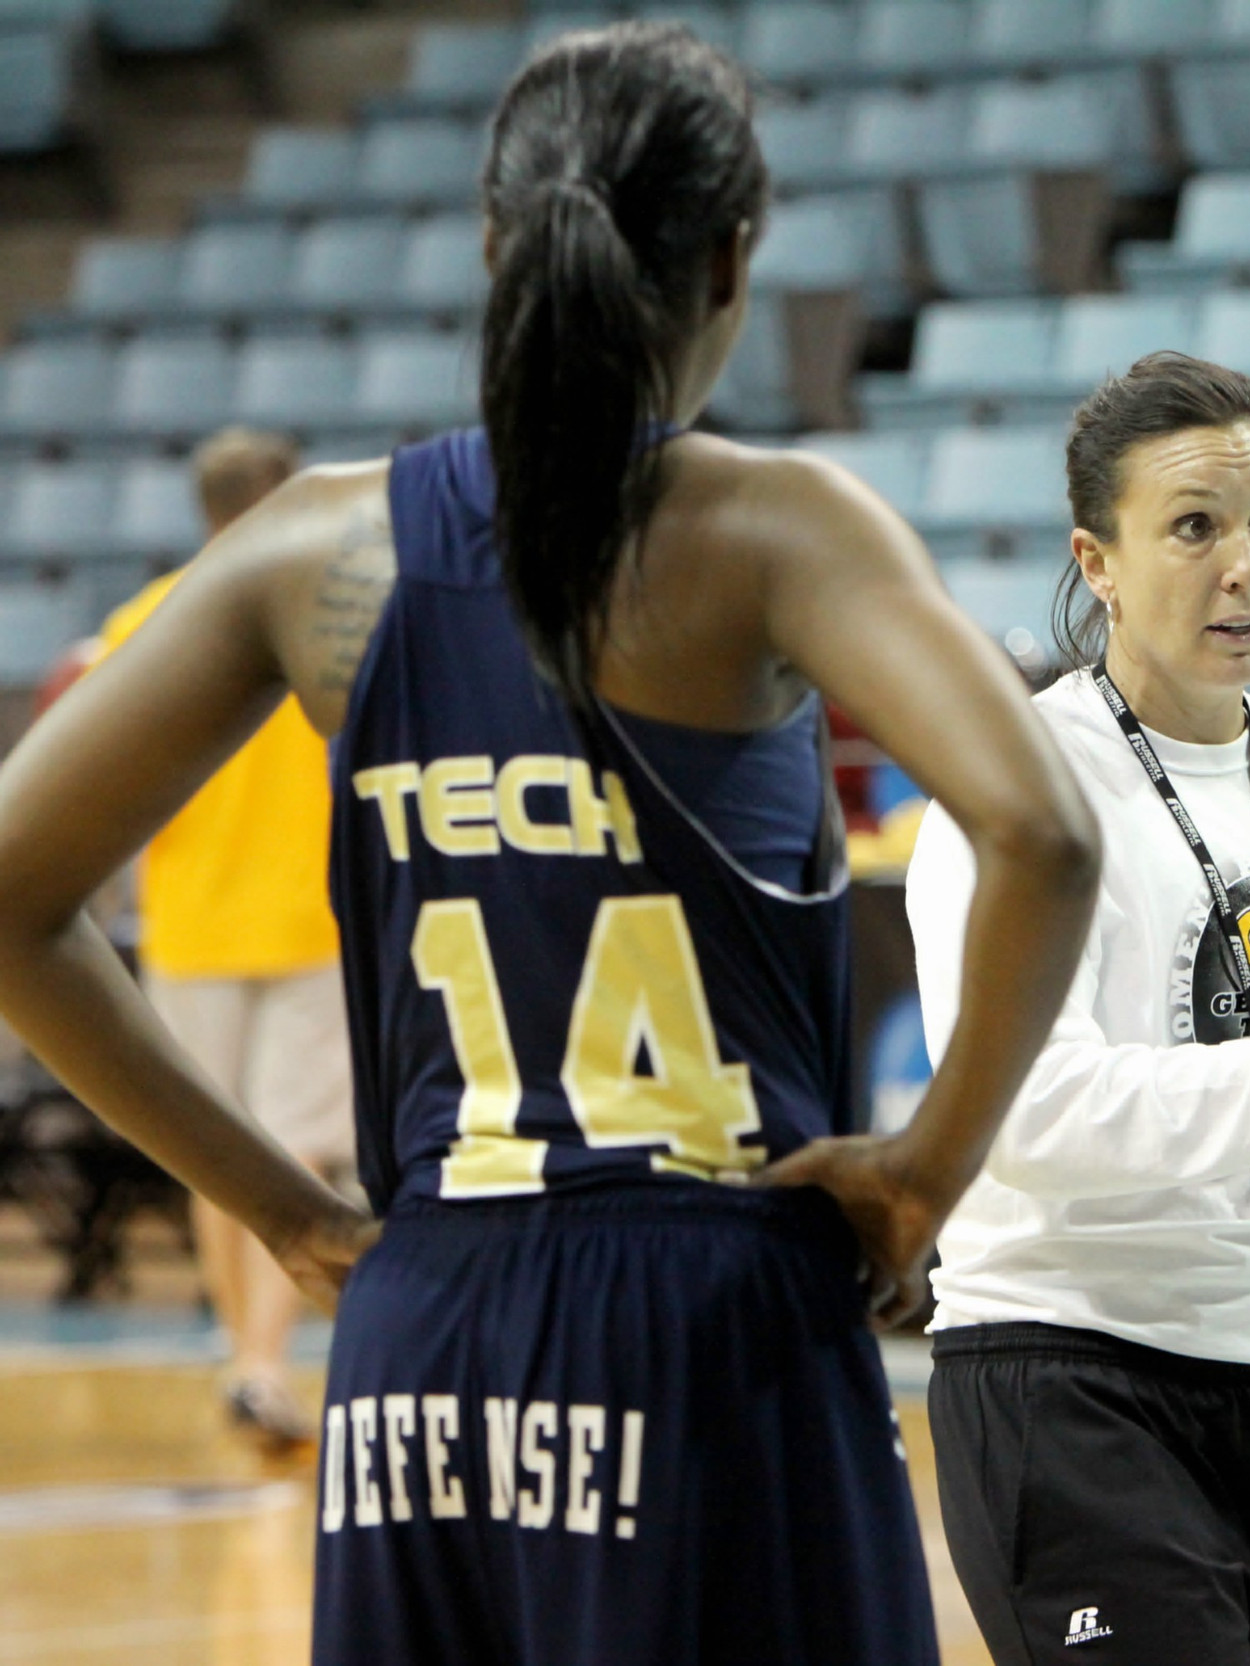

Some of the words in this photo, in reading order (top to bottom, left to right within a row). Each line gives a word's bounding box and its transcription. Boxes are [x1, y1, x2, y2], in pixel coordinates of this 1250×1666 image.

[1127, 732, 1164, 780] RUSSELL
[352, 754, 643, 864] TECH
[1165, 798, 1201, 845] RUSSELL
[1202, 864, 1231, 915] RUSSELL
[410, 894, 768, 1199] 14
[1064, 1625, 1113, 1647] RUSSELL
